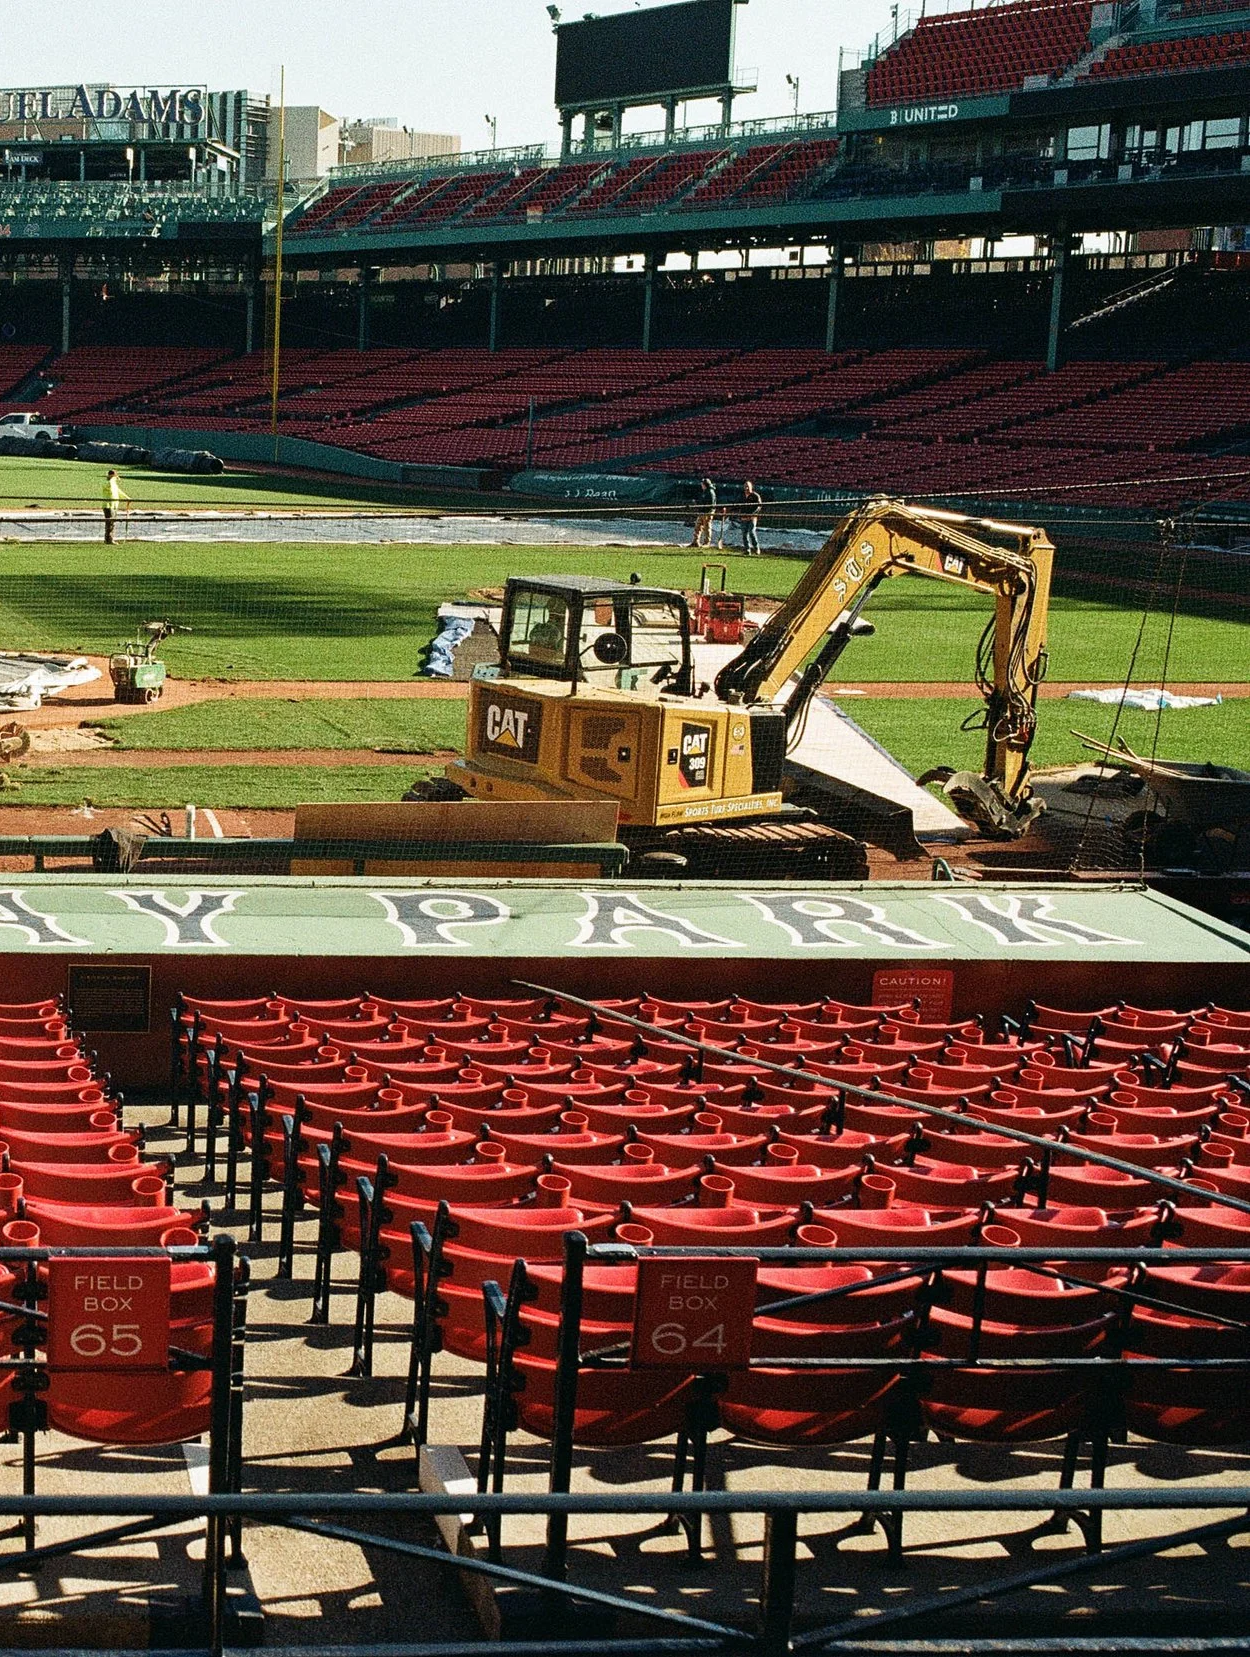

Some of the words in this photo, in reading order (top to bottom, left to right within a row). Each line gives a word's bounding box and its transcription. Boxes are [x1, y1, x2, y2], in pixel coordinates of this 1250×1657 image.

[69, 84, 207, 126] ADAMS
[944, 553, 964, 575] CAT
[487, 704, 529, 749] CAT
[683, 733, 708, 755] CAT
[689, 757, 706, 770] 309
[364, 891, 1146, 950] PARK
[879, 977, 947, 986] CAUTION!
[75, 1276, 143, 1290] FIELD
[661, 1275, 729, 1289] FIELD
[84, 1297, 132, 1311] BOX
[669, 1296, 718, 1310] BOX
[70, 1324, 143, 1357] 65
[652, 1322, 727, 1355] 64
